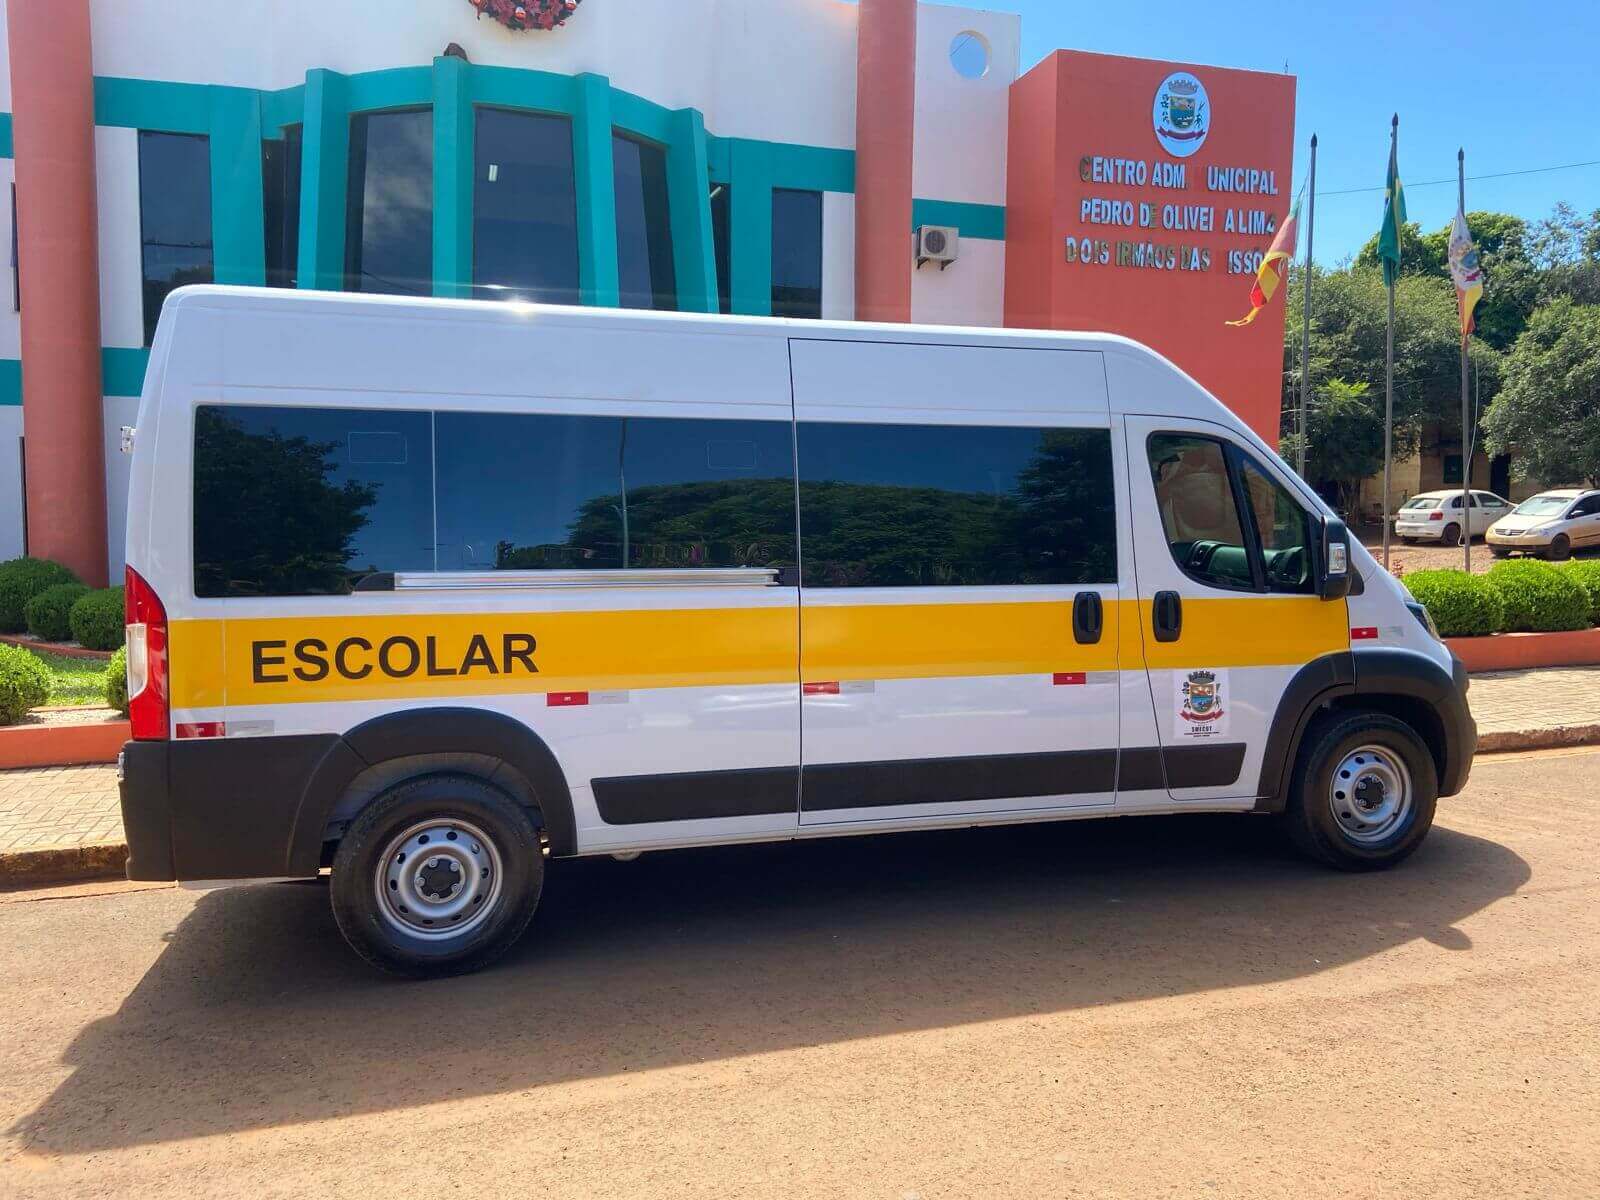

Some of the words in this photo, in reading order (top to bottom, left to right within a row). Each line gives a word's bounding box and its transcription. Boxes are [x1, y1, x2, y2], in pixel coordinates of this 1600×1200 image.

[1080, 156, 1147, 185] CENTRO
[1081, 198, 1134, 226] PEDRO
[1139, 202, 1158, 229] DE
[1066, 236, 1109, 264] DOIS
[1181, 244, 1210, 272] DAS
[252, 633, 539, 683] ESCOLAR
